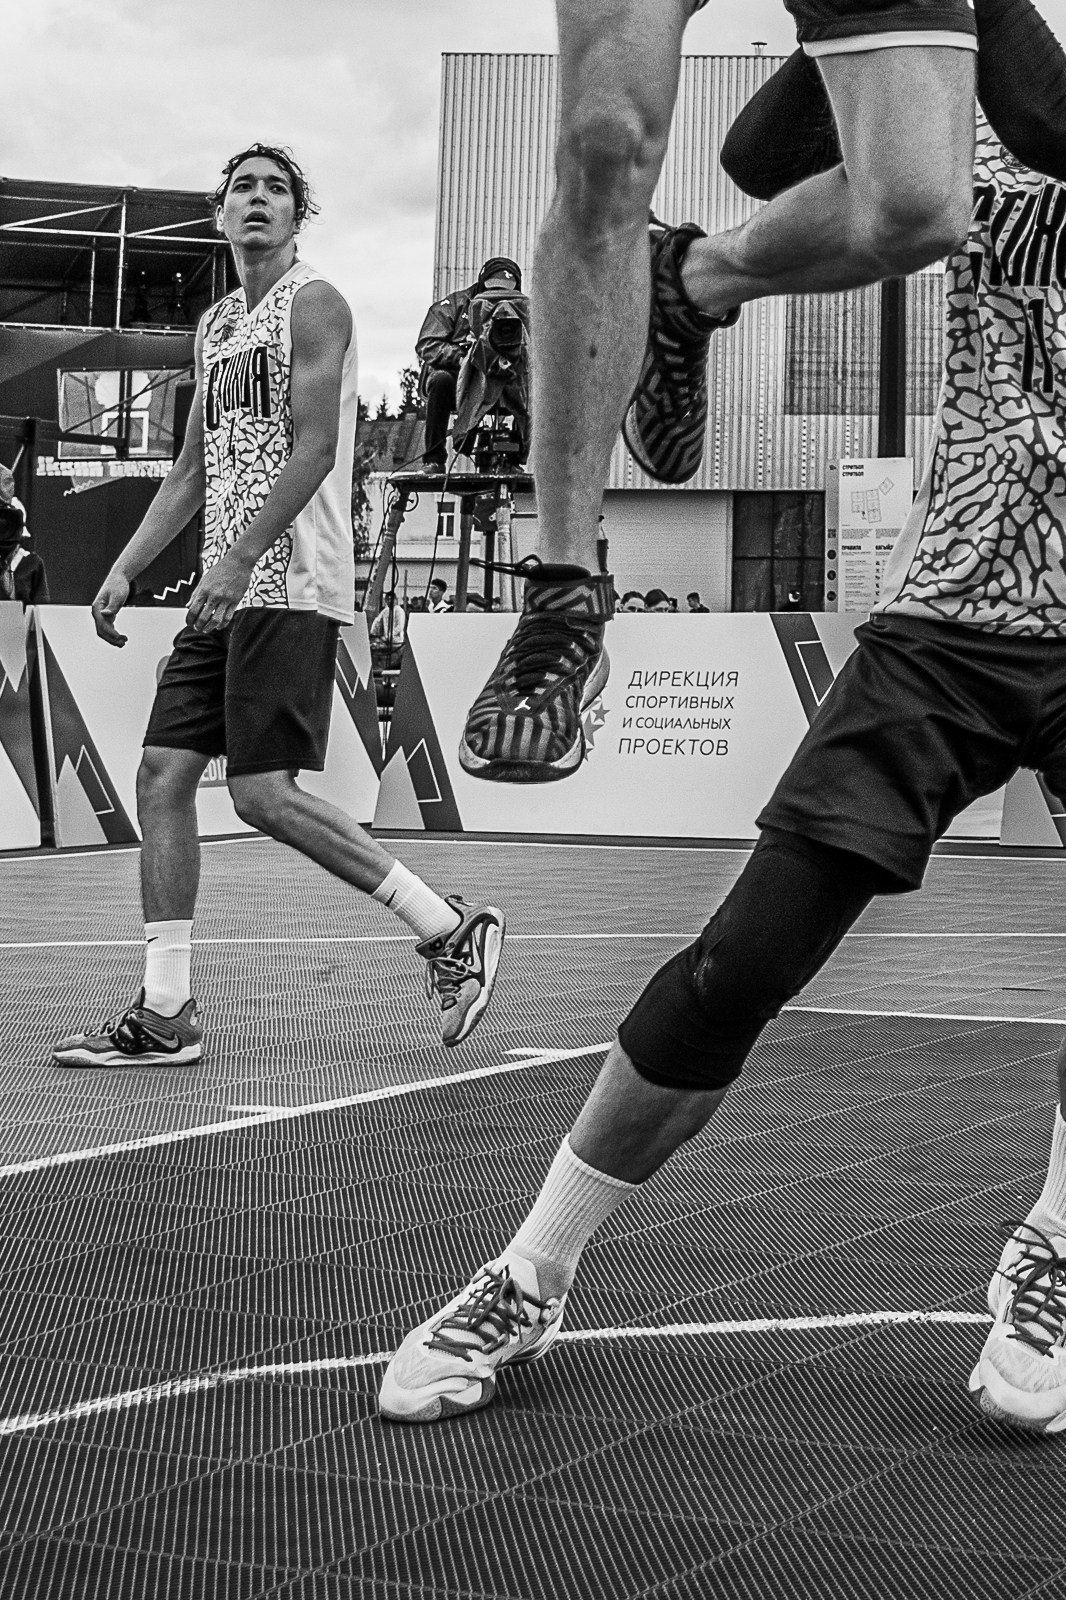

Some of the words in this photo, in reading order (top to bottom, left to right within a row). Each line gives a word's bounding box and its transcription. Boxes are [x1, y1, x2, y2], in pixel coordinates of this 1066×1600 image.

[627, 670, 740, 690] ДИРЕКЦИЯ
[625, 695, 735, 710] СПОРТИВНЫХ
[622, 717, 633, 729] И
[635, 717, 732, 731] СОЦИАЛЬНЫХ
[618, 737, 730, 756] ПРОЕКТОВ
